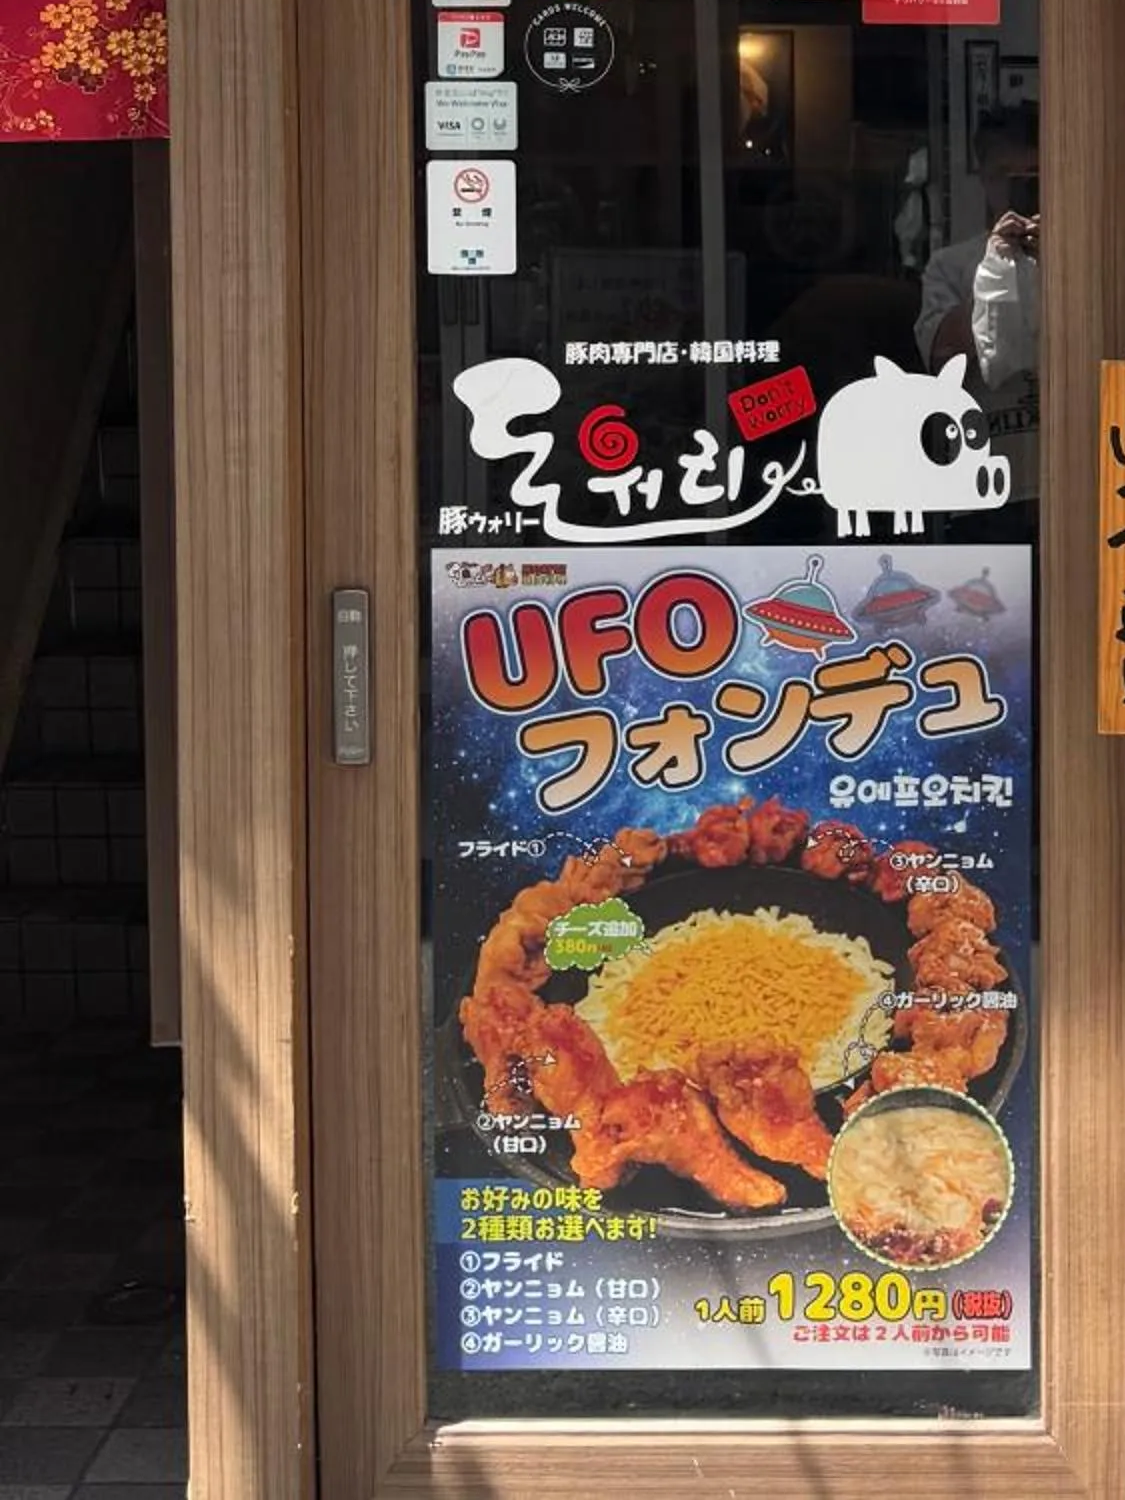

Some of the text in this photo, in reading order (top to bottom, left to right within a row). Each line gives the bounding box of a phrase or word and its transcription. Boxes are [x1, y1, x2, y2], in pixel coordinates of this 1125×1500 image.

[437, 121, 461, 130] VISA
[565, 340, 781, 366] 豚肉専門店・韓国料理
[438, 507, 540, 535] 豚ウォリー
[461, 568, 739, 713] UFO
[518, 641, 1006, 816] フォンデュ
[829, 773, 1014, 809] 유에프오치킨
[458, 839, 546, 858] フライド①
[889, 852, 994, 870] ③ヤンニョム
[555, 921, 638, 937] チーズ追加
[555, 939, 597, 955] 380円
[880, 991, 1018, 1010] ④ガーリック醤油
[476, 1113, 581, 1132] ②ヤンニョム
[460, 1185, 603, 1212] お好みの味を
[460, 1215, 658, 1243] 2種類お選べます!
[459, 1251, 565, 1274] ①フライド
[694, 1295, 767, 1324] 1人前
[768, 1269, 948, 1323] 1280円
[460, 1332, 629, 1355] ④ガーリック醤油
